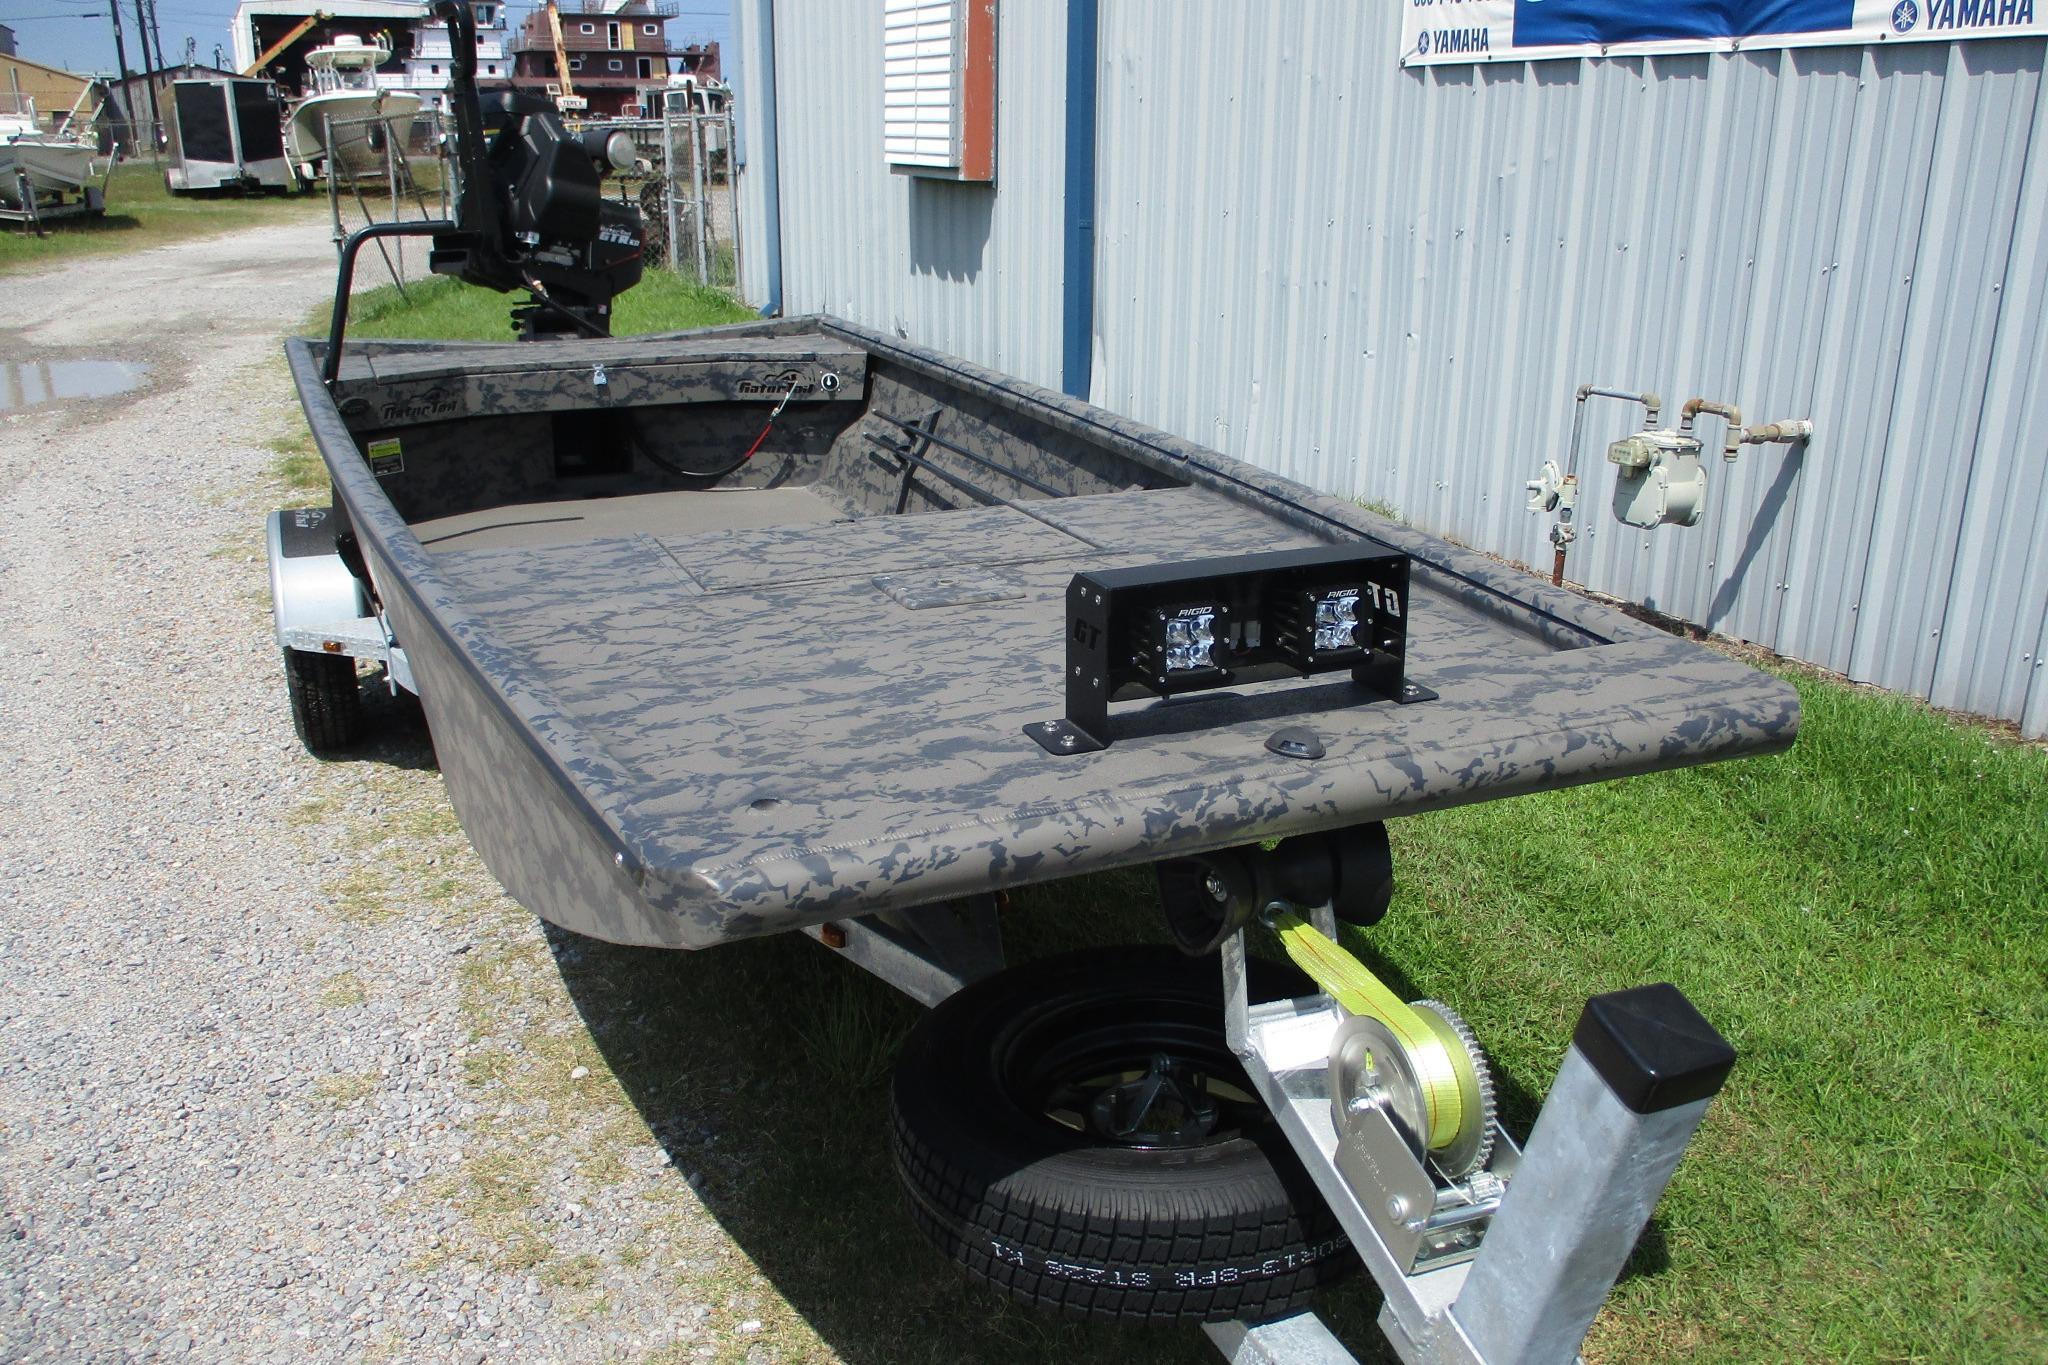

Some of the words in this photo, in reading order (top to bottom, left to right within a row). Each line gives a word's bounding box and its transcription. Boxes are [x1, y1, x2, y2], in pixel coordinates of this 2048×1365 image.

[1926, 0, 2034, 30] YAMAHA
[1433, 28, 1489, 54] YAMAHA
[599, 231, 631, 245] GTR
[1327, 588, 1359, 599] RIGID
[1177, 606, 1213, 617] RIGID
[1073, 617, 1101, 650] GT
